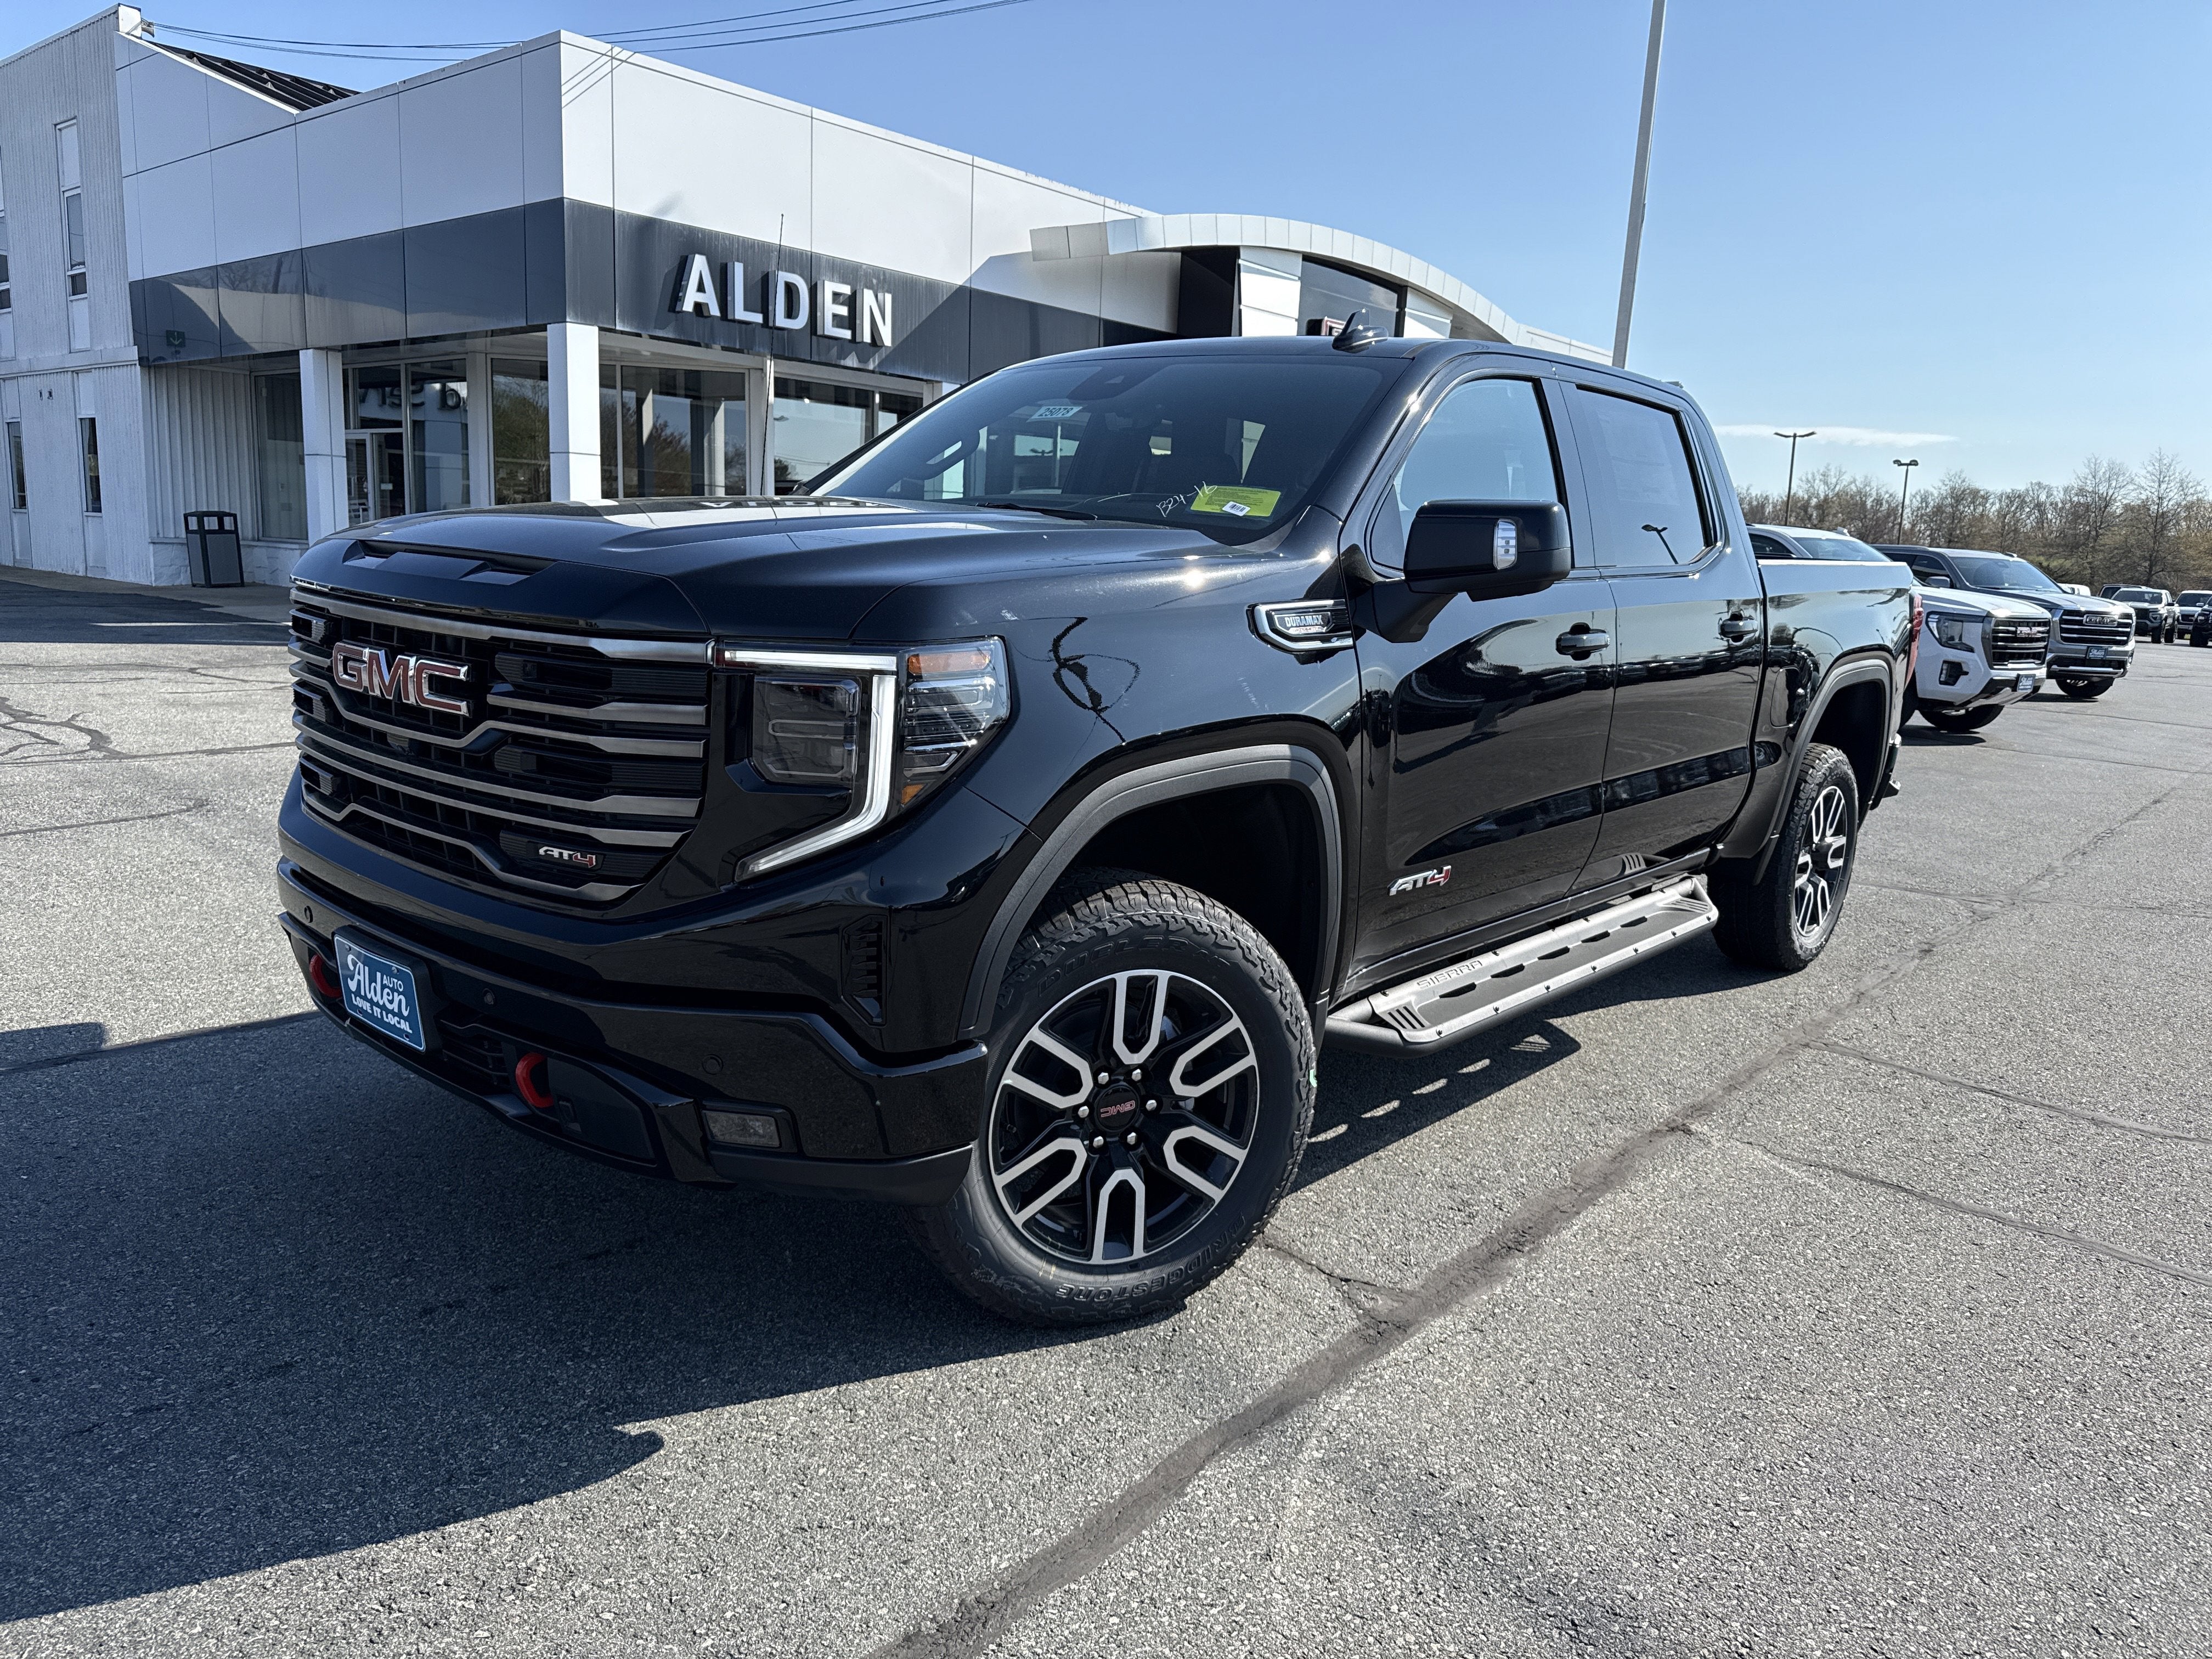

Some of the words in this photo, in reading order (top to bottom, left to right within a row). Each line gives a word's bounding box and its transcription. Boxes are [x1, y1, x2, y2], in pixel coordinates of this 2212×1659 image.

[678, 253, 893, 347] ALDEN
[1037, 408, 1074, 417] 25078
[1284, 614, 1324, 627] DURAMAX
[2086, 616, 2117, 625] GMC
[332, 642, 469, 717] GMC
[539, 846, 596, 868] AT4
[1389, 865, 1452, 896] AT4
[347, 954, 410, 1017] Alden
[383, 974, 404, 992] AUTO
[1417, 960, 1483, 989] SIERRA
[352, 994, 372, 1014] LOVE
[373, 1006, 381, 1019] IT
[382, 1011, 413, 1034] LOCAL
[1101, 1100, 1136, 1118] GMC
[1056, 1211, 1246, 1302] BRIDGESTONE
